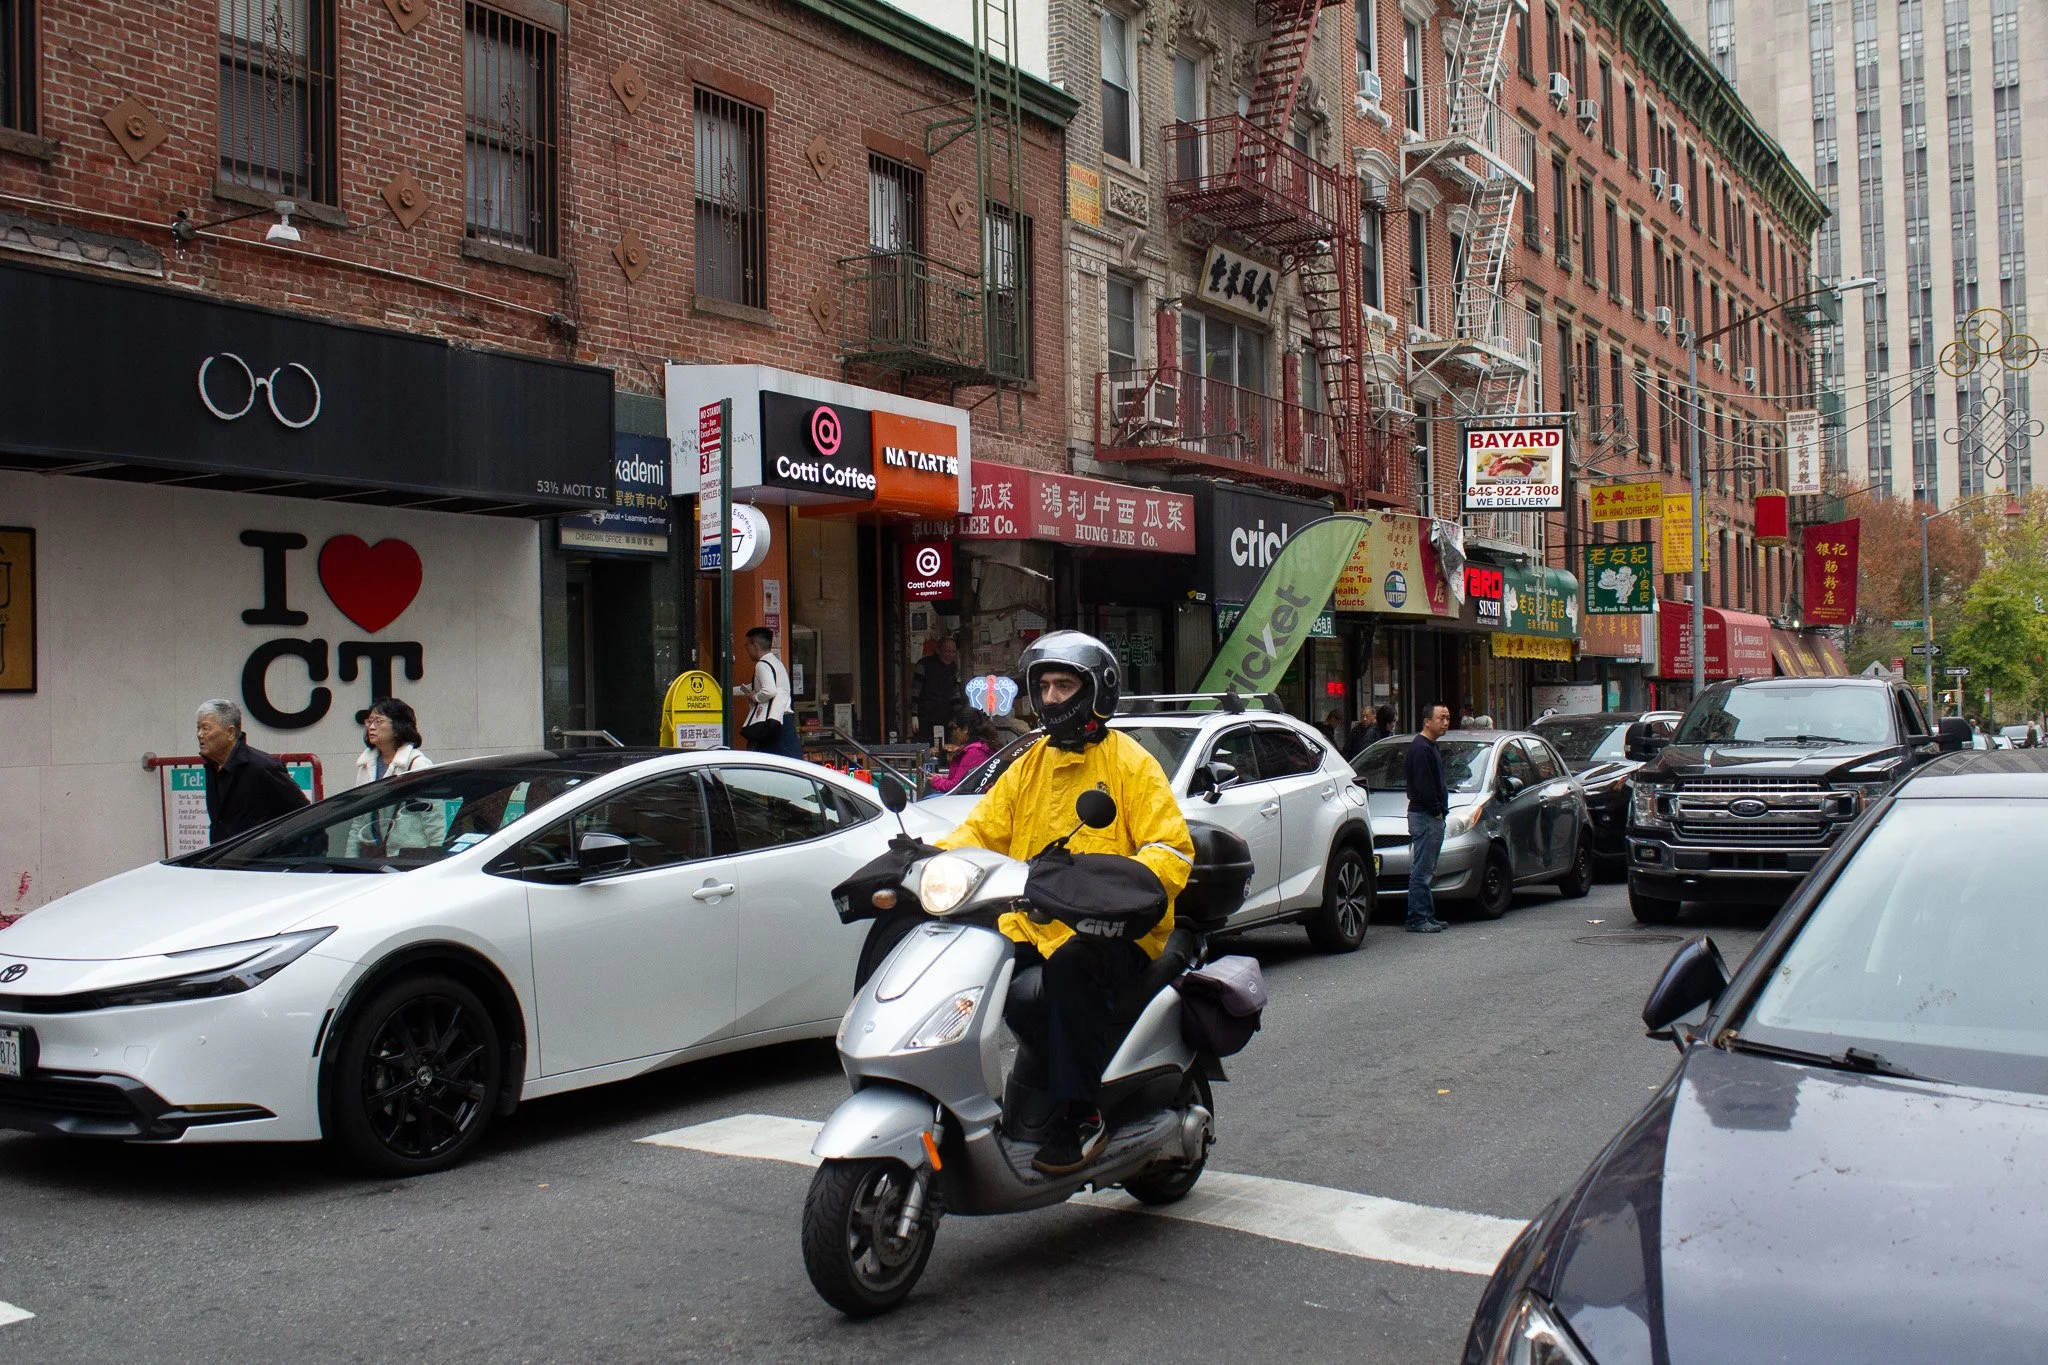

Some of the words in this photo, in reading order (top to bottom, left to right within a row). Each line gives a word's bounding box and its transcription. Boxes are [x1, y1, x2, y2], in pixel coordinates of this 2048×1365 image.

[1469, 431, 1560, 449] BAYARD
[702, 455, 708, 473] 3
[885, 446, 907, 467] NA
[908, 450, 947, 473] TART
[615, 453, 664, 486] kademi
[776, 455, 819, 483] Cotti
[822, 463, 877, 490] Coffee
[1495, 476, 1532, 486] SUSHI
[562, 483, 592, 498] MOTT
[595, 486, 608, 499] ST.
[1476, 498, 1494, 506] WE
[1497, 498, 1550, 506] DELIVERY
[1625, 505, 1643, 516] COFFEE
[1645, 504, 1660, 514] SHOP
[959, 515, 990, 535] LEE
[994, 514, 1018, 535] Co.
[1075, 523, 1108, 543] HUNG
[1112, 528, 1135, 546] LEE
[1141, 531, 1158, 547] Co.
[1230, 519, 1287, 568] cric
[1589, 546, 1648, 565] 老友記
[239, 529, 309, 626] I
[1344, 564, 1364, 573] seng
[907, 581, 925, 589] Cotti
[926, 580, 950, 588] Coffee
[1338, 576, 1355, 584] ese
[1357, 575, 1373, 584] Tea
[1336, 599, 1366, 607] oducts
[1478, 599, 1501, 617] SUSHI
[240, 637, 424, 730] CT
[180, 771, 204, 787] Tel:
[1076, 918, 1125, 938] GIVI
[0, 1040, 17, 1066] 873
